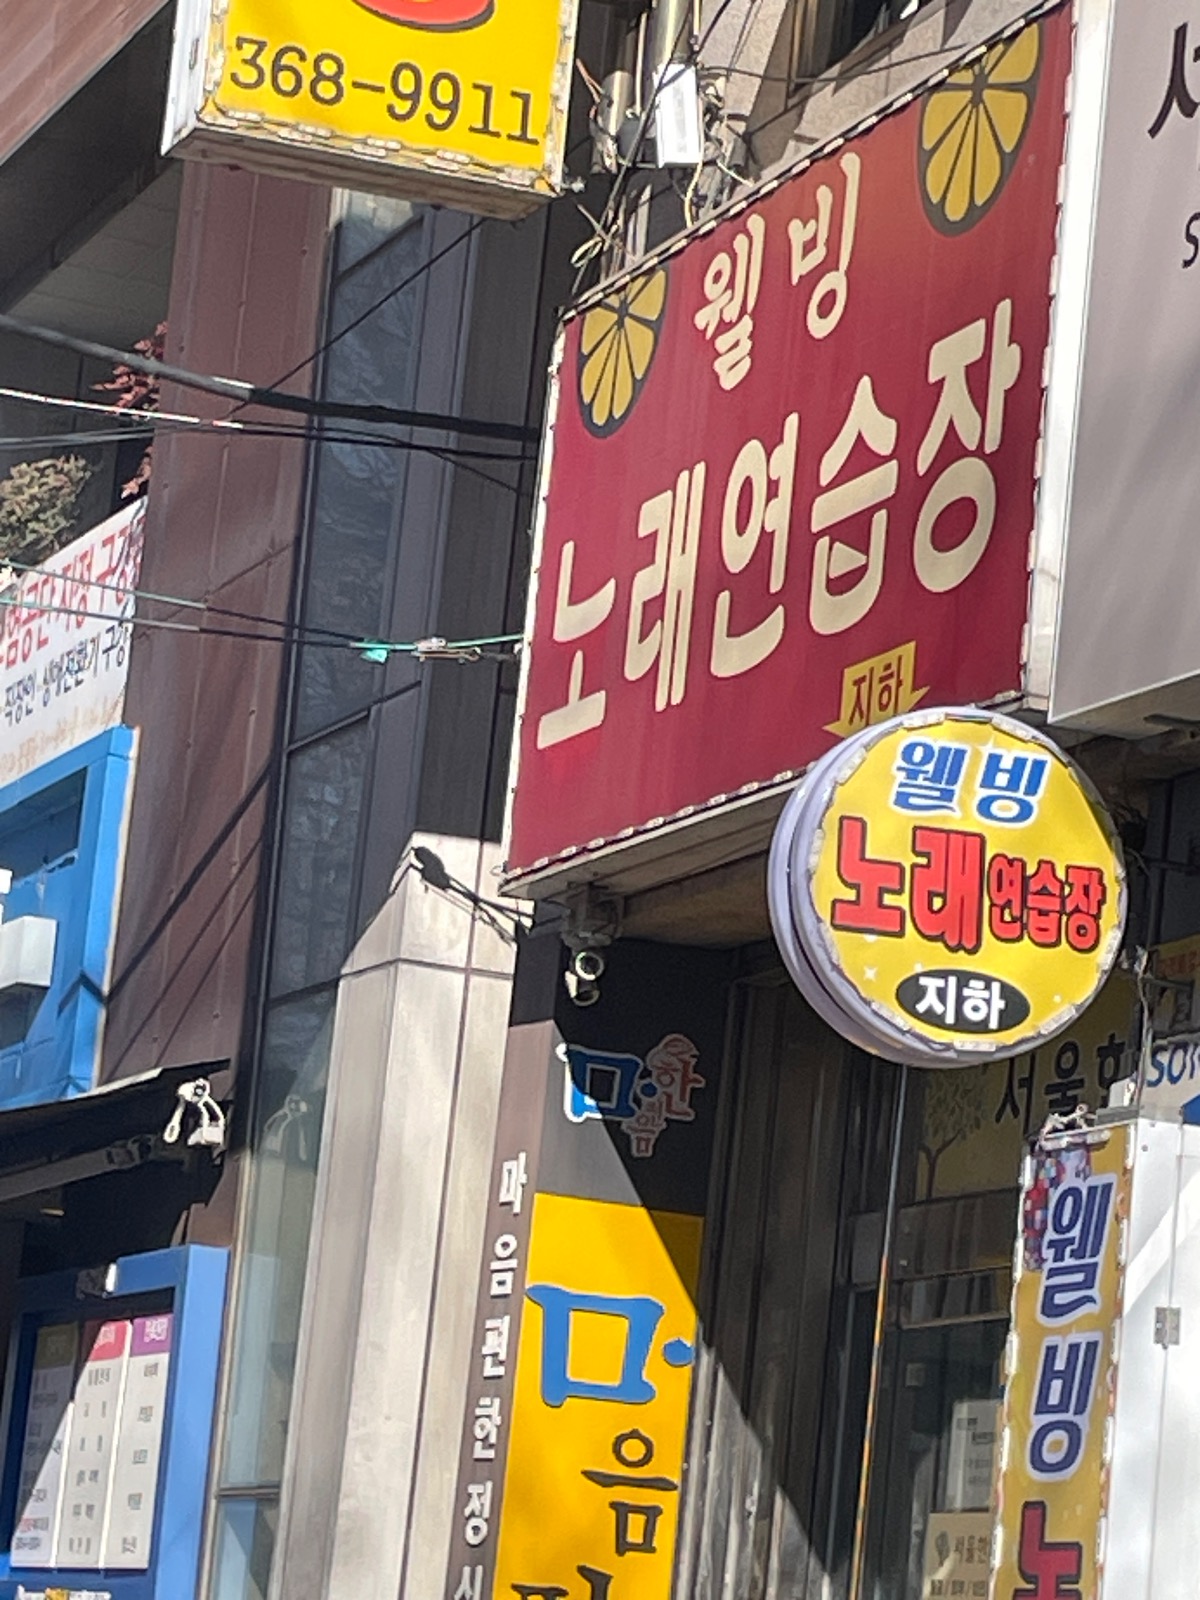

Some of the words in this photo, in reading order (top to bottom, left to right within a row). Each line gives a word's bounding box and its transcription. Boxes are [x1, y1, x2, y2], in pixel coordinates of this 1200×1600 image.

[230, 36, 540, 145] 368-9911
[694, 151, 861, 391] 웰빙
[537, 298, 1022, 749] 노래연습장
[848, 654, 904, 726] 지하
[892, 740, 1048, 824] 웰빙
[831, 815, 1107, 955] 노래연습장
[915, 975, 1006, 1030] 지하
[1029, 1182, 1114, 1474] 웰빙
